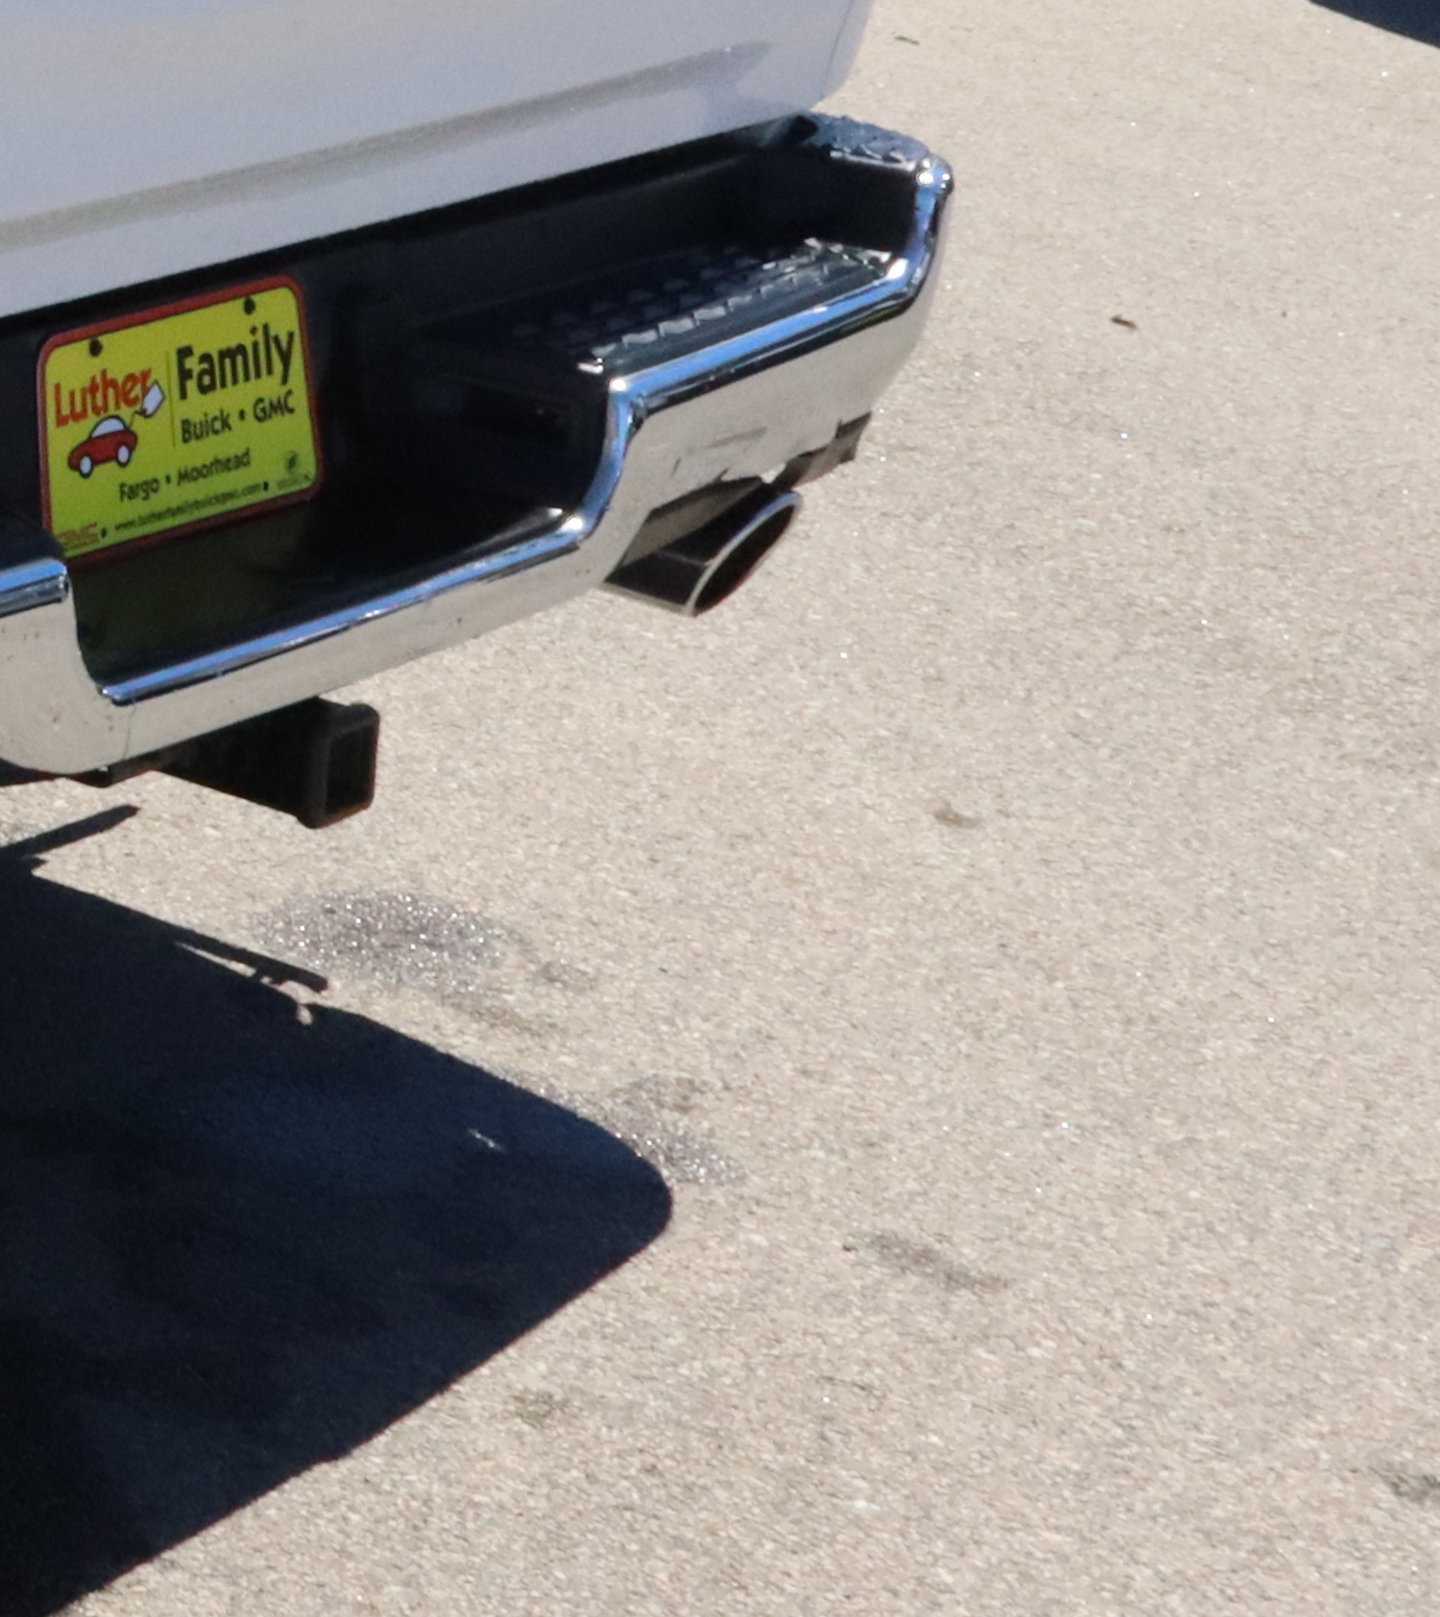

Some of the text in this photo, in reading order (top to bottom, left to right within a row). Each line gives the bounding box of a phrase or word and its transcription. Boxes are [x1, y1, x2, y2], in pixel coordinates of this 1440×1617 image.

[176, 323, 295, 400] Family
[54, 367, 153, 427] Luther
[181, 390, 296, 444] Buick GMC
[118, 475, 161, 503] Fargo
[177, 448, 251, 486] Moorhead
